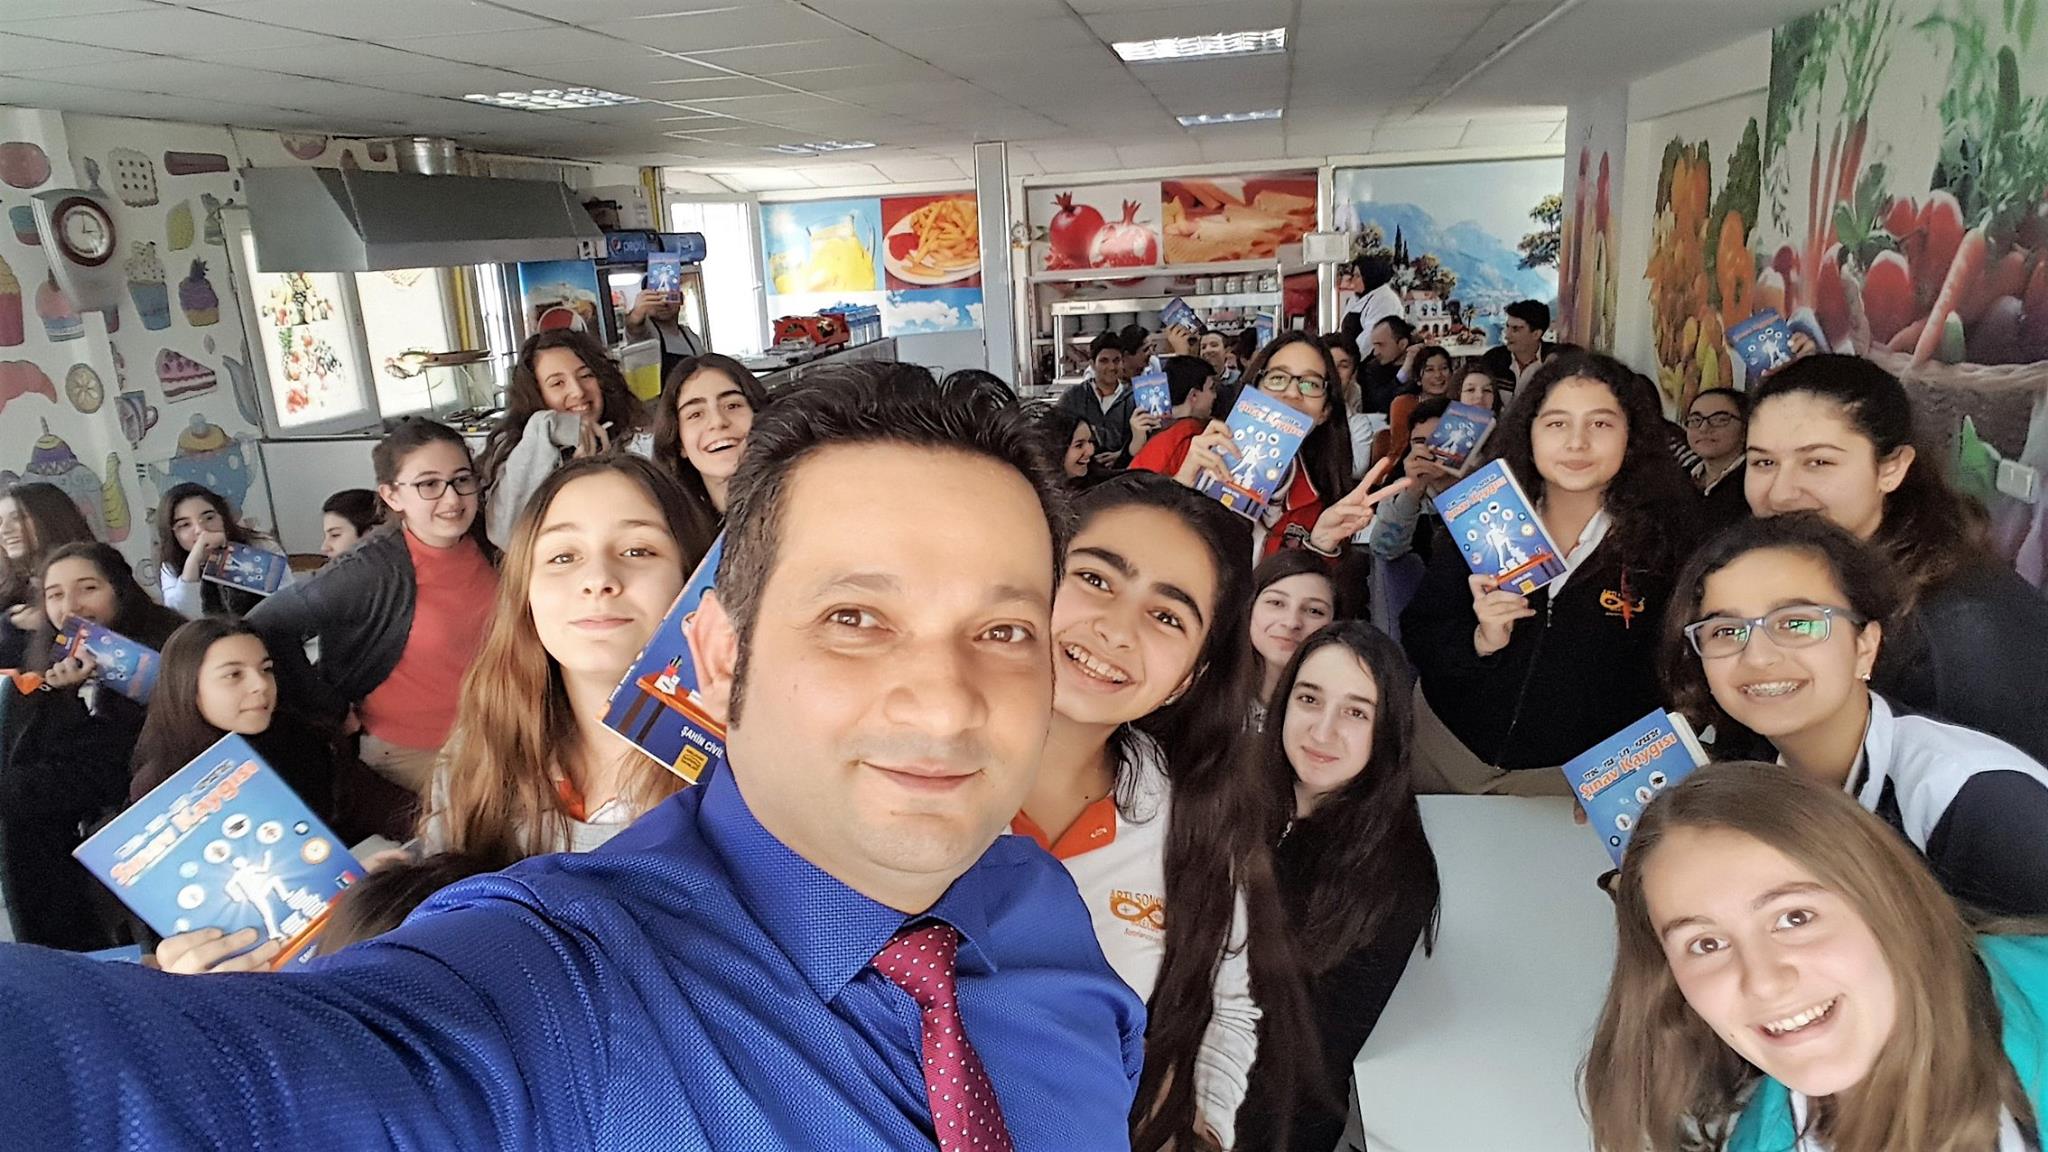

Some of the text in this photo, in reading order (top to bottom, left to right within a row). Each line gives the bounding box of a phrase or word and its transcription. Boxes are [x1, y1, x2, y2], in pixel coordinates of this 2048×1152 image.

[680, 726, 705, 746] ŞAHİN
[1579, 733, 1677, 796] Sınav Kaygısı
